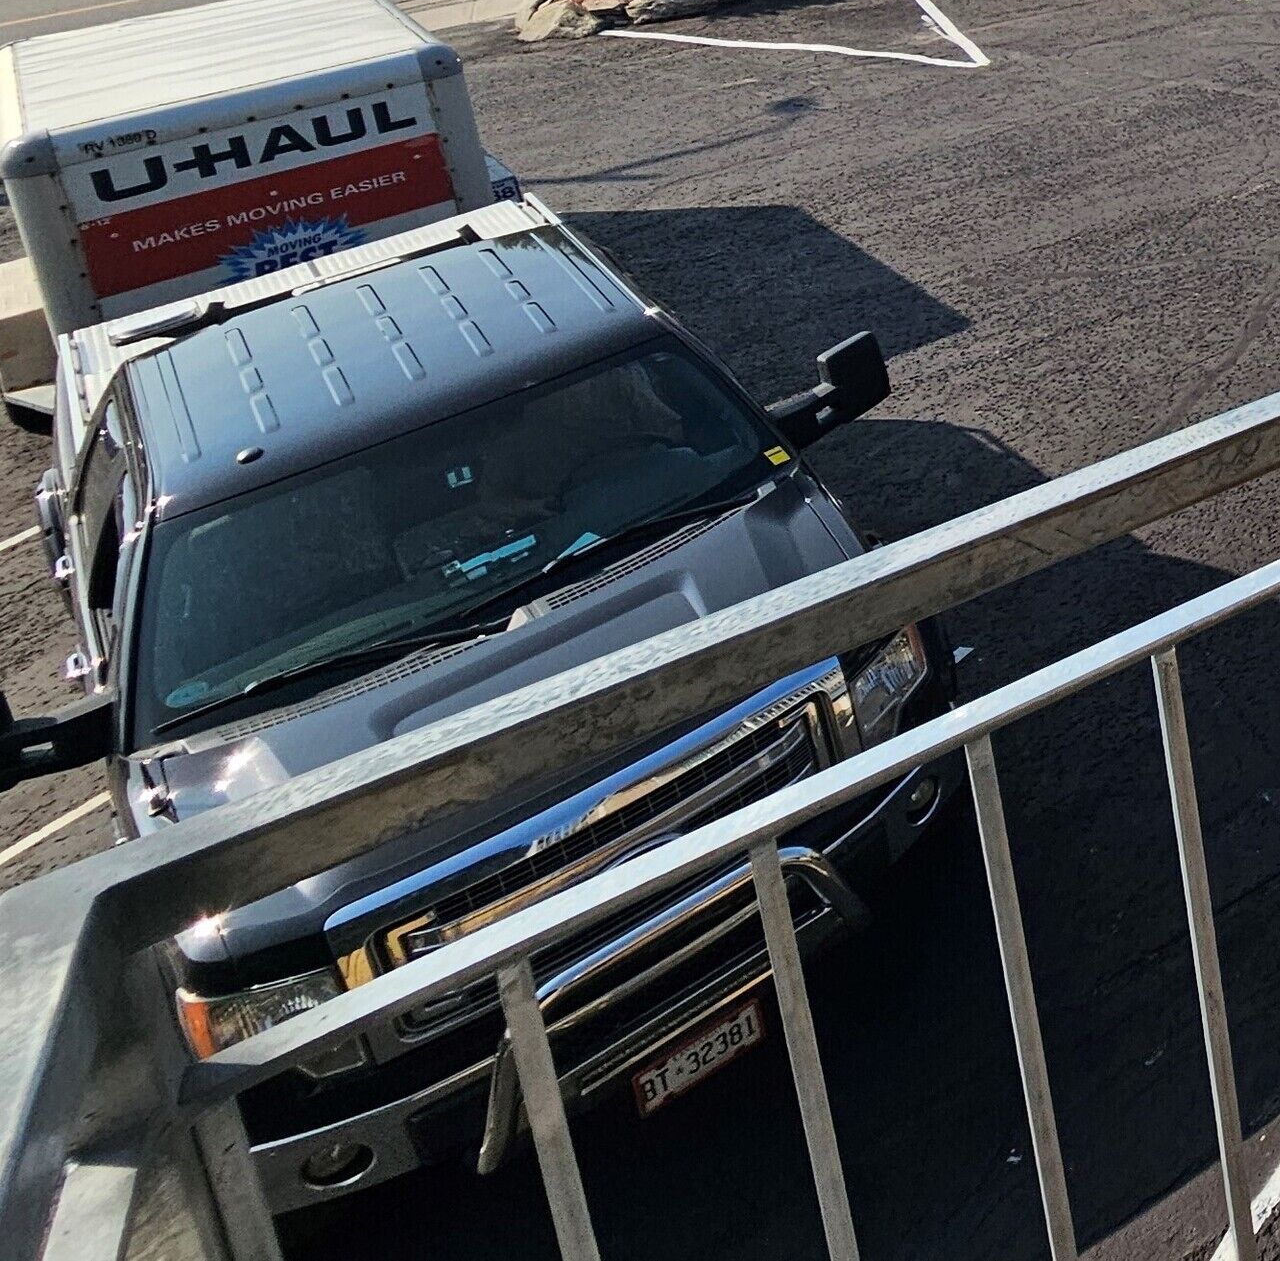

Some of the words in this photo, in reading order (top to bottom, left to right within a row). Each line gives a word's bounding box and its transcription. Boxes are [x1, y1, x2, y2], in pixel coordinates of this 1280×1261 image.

[90, 101, 418, 203] U-HAUL
[132, 219, 221, 252] MAKES
[226, 191, 324, 227] MOVING
[330, 171, 407, 200] EASIER
[267, 233, 322, 258] MOVING
[642, 1067, 670, 1101] BT
[686, 1014, 757, 1075] 32381
